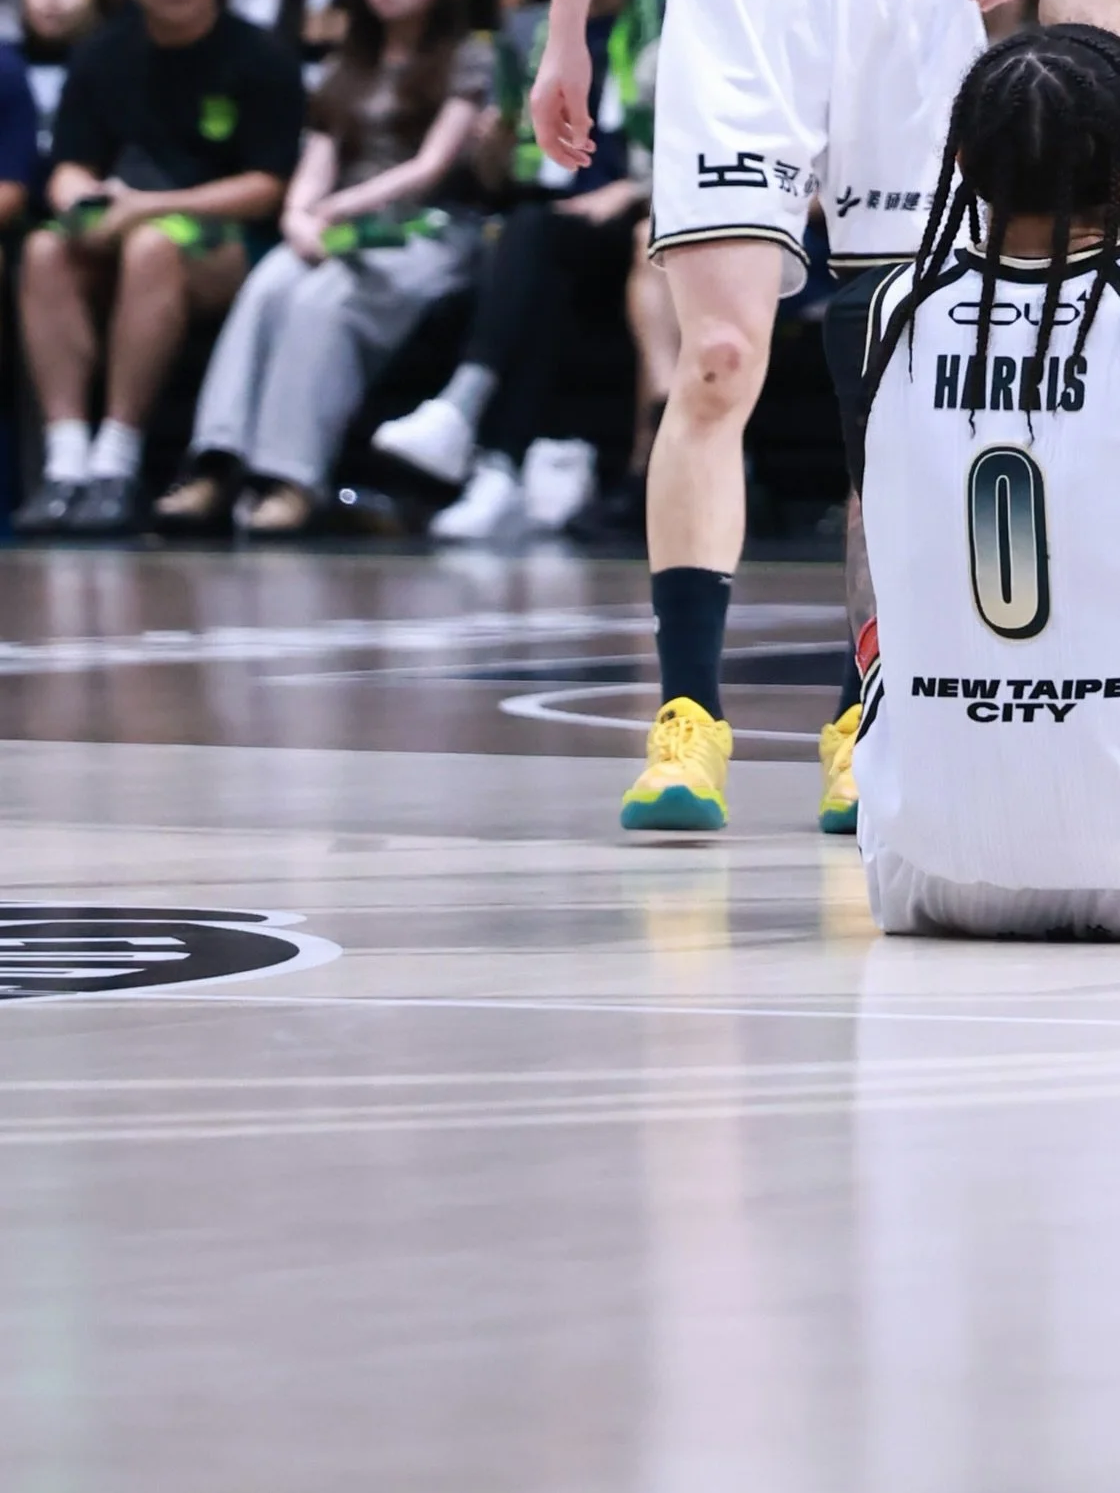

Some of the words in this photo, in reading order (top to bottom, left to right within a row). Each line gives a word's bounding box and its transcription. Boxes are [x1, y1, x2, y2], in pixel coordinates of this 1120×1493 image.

[934, 354, 1088, 412] HARRIS
[967, 442, 1052, 642] 0
[911, 676, 1000, 700] NEW
[966, 702, 1077, 724] CITY
